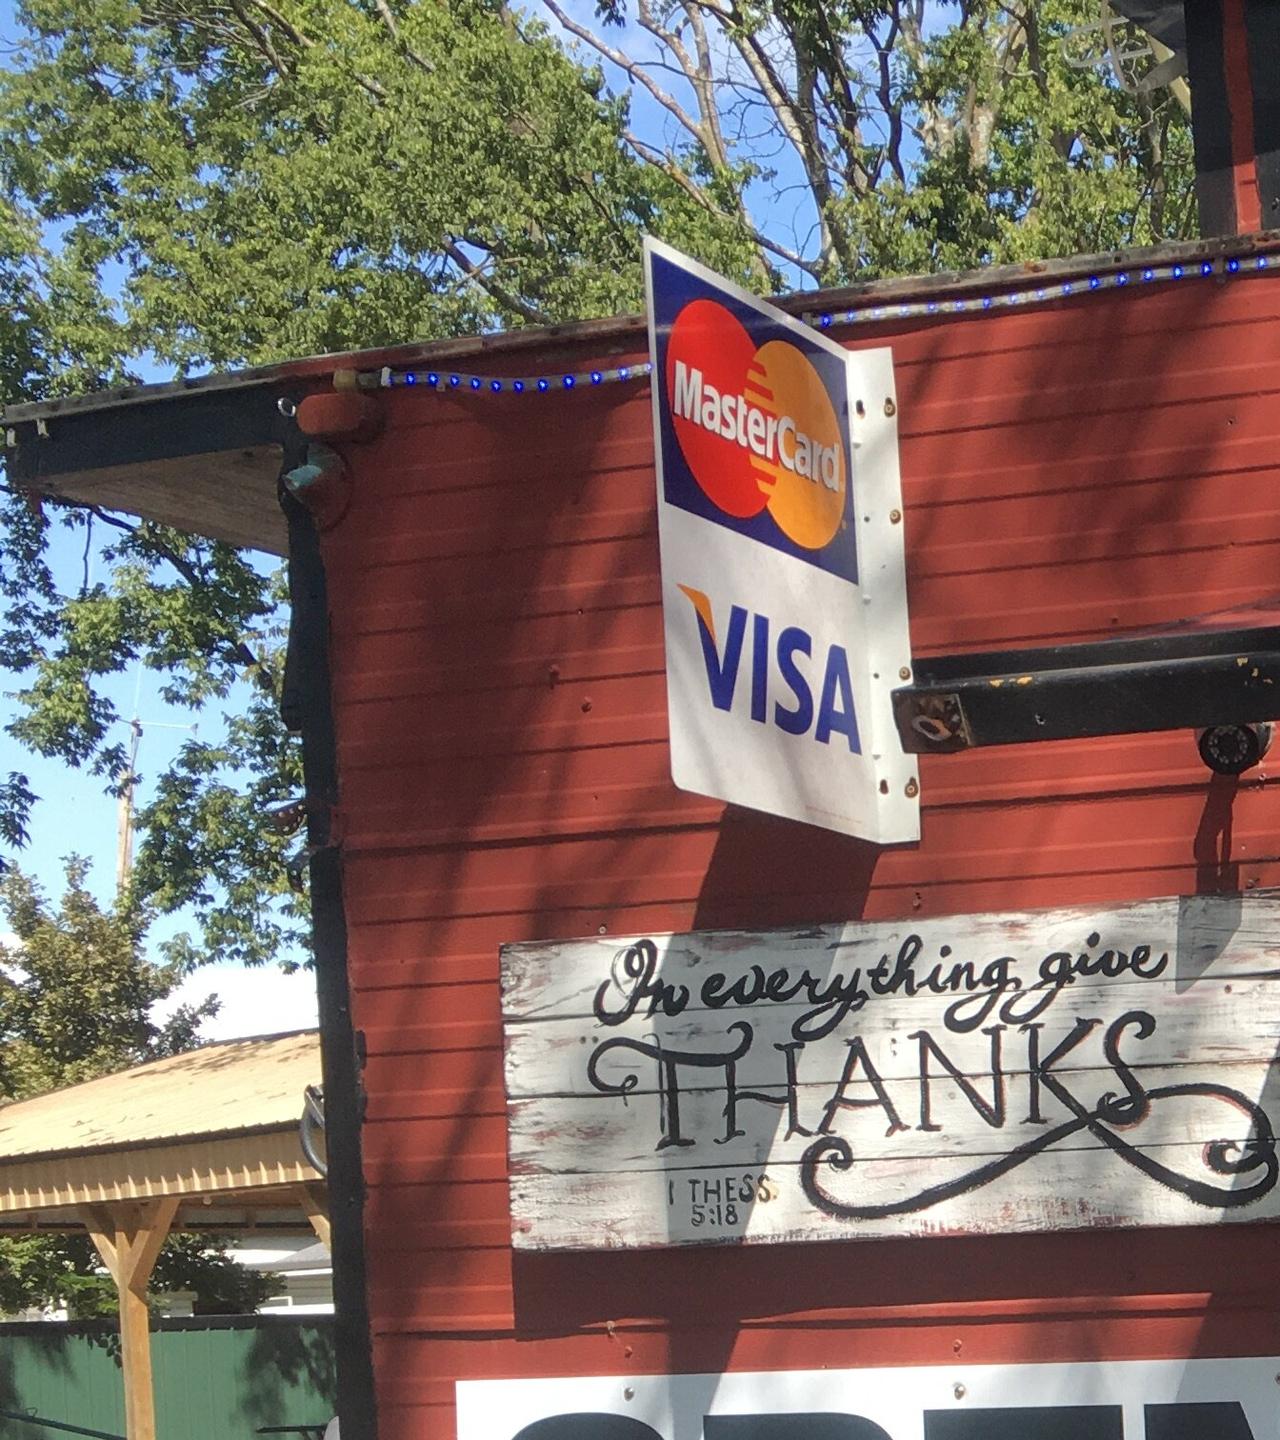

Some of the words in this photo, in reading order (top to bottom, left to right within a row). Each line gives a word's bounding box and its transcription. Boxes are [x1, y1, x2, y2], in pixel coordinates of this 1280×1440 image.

[672, 359, 842, 493] MasterCard
[676, 583, 863, 756] VISA
[701, 934, 1022, 1042] everything
[1004, 930, 1173, 1026] give
[588, 1008, 1280, 1219] THANKS
[690, 1203, 739, 1227] 5:18
